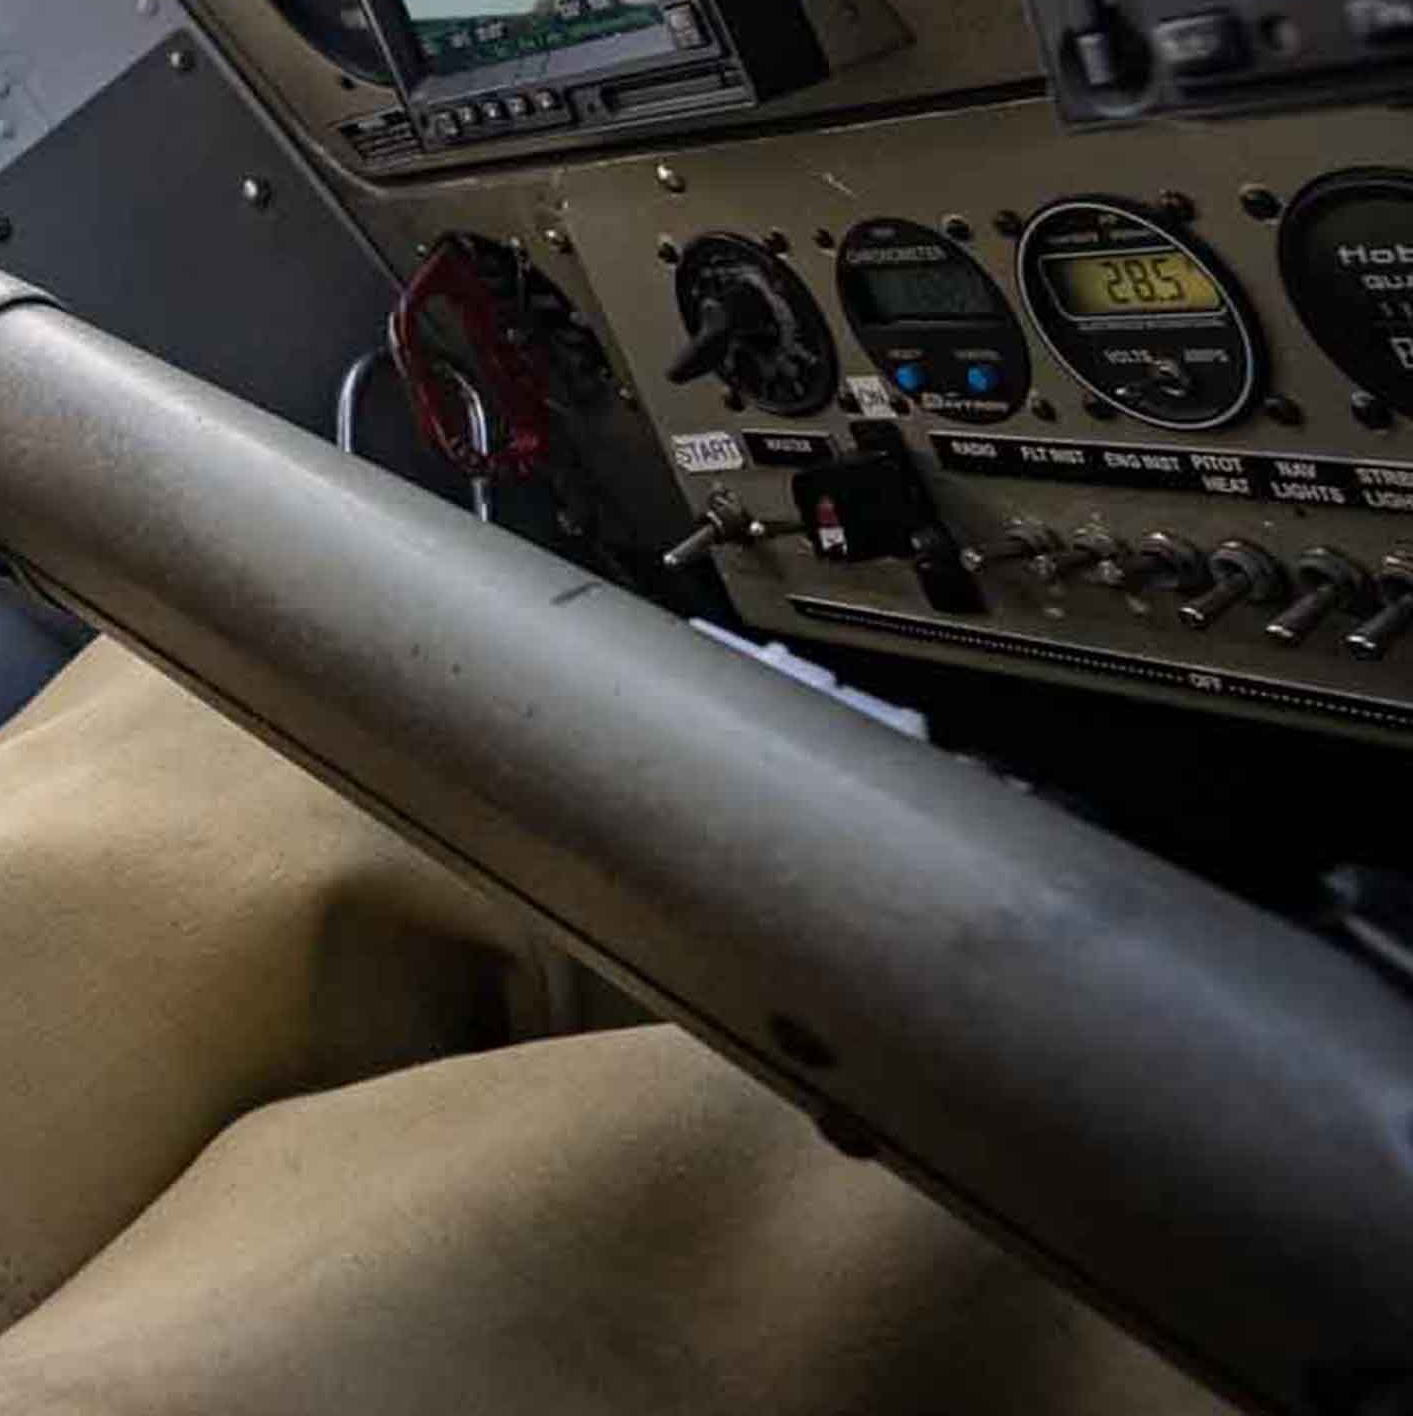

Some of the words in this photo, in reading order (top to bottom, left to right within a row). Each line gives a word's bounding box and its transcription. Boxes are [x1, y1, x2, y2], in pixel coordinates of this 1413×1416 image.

[1101, 257, 1185, 304] 28.5
[677, 436, 743, 464] START
[1189, 453, 1245, 474] PITOT
[1275, 460, 1318, 480] NAV
[1270, 481, 1346, 505] LIGHTS
